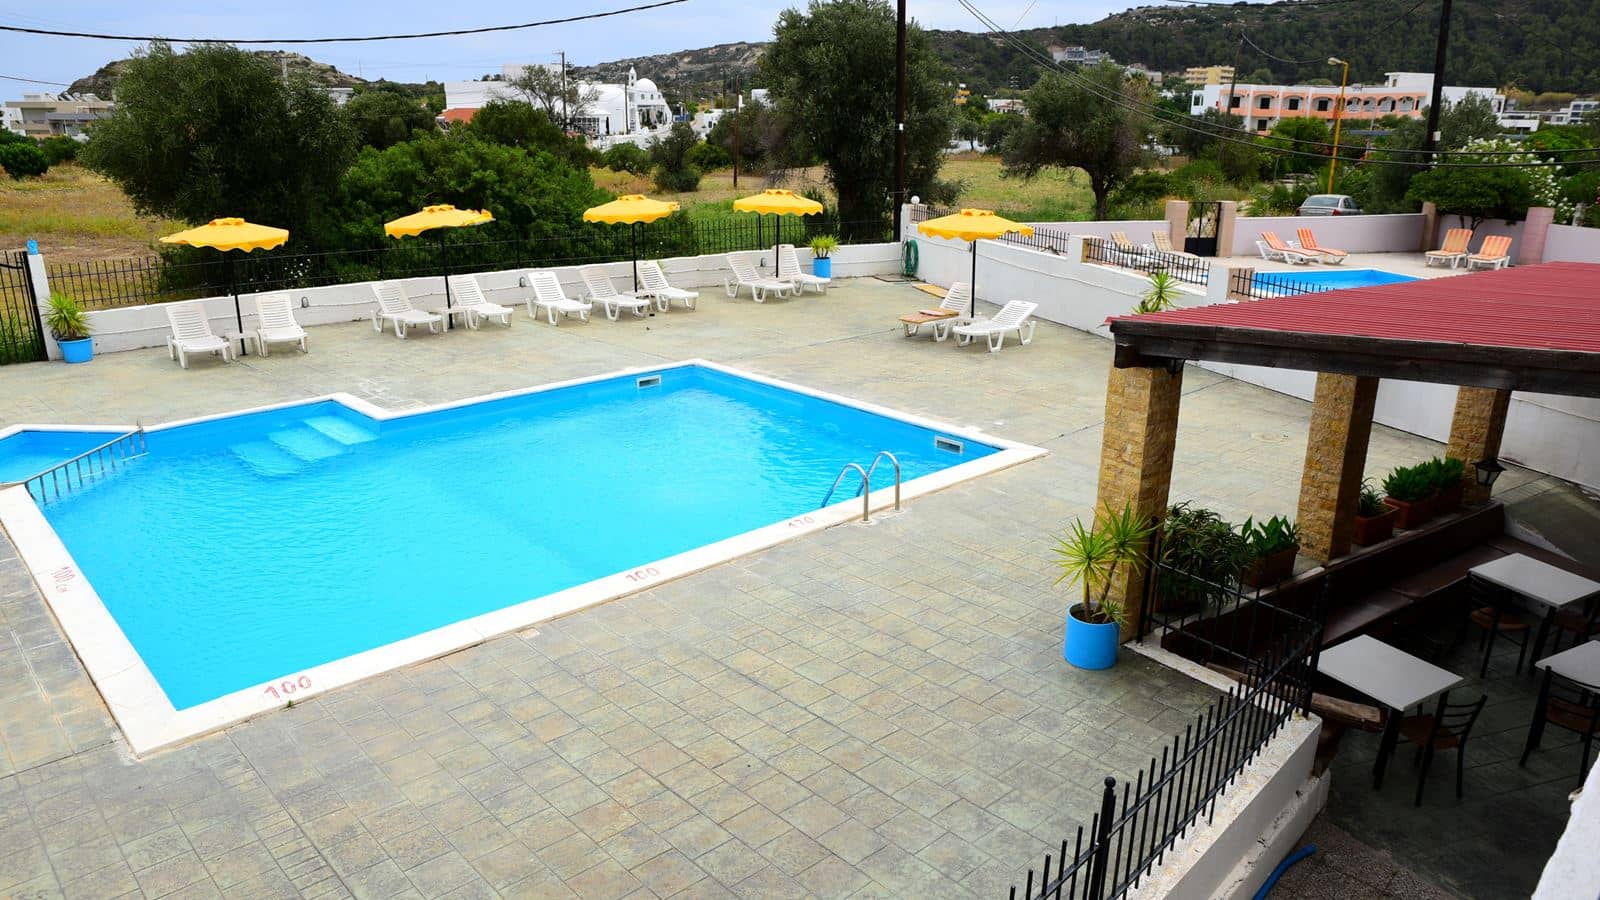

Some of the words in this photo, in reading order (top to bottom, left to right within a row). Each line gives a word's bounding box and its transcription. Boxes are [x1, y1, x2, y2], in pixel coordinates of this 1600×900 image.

[51, 566, 76, 583] 100
[625, 567, 661, 582] 100
[263, 675, 312, 700] 100
